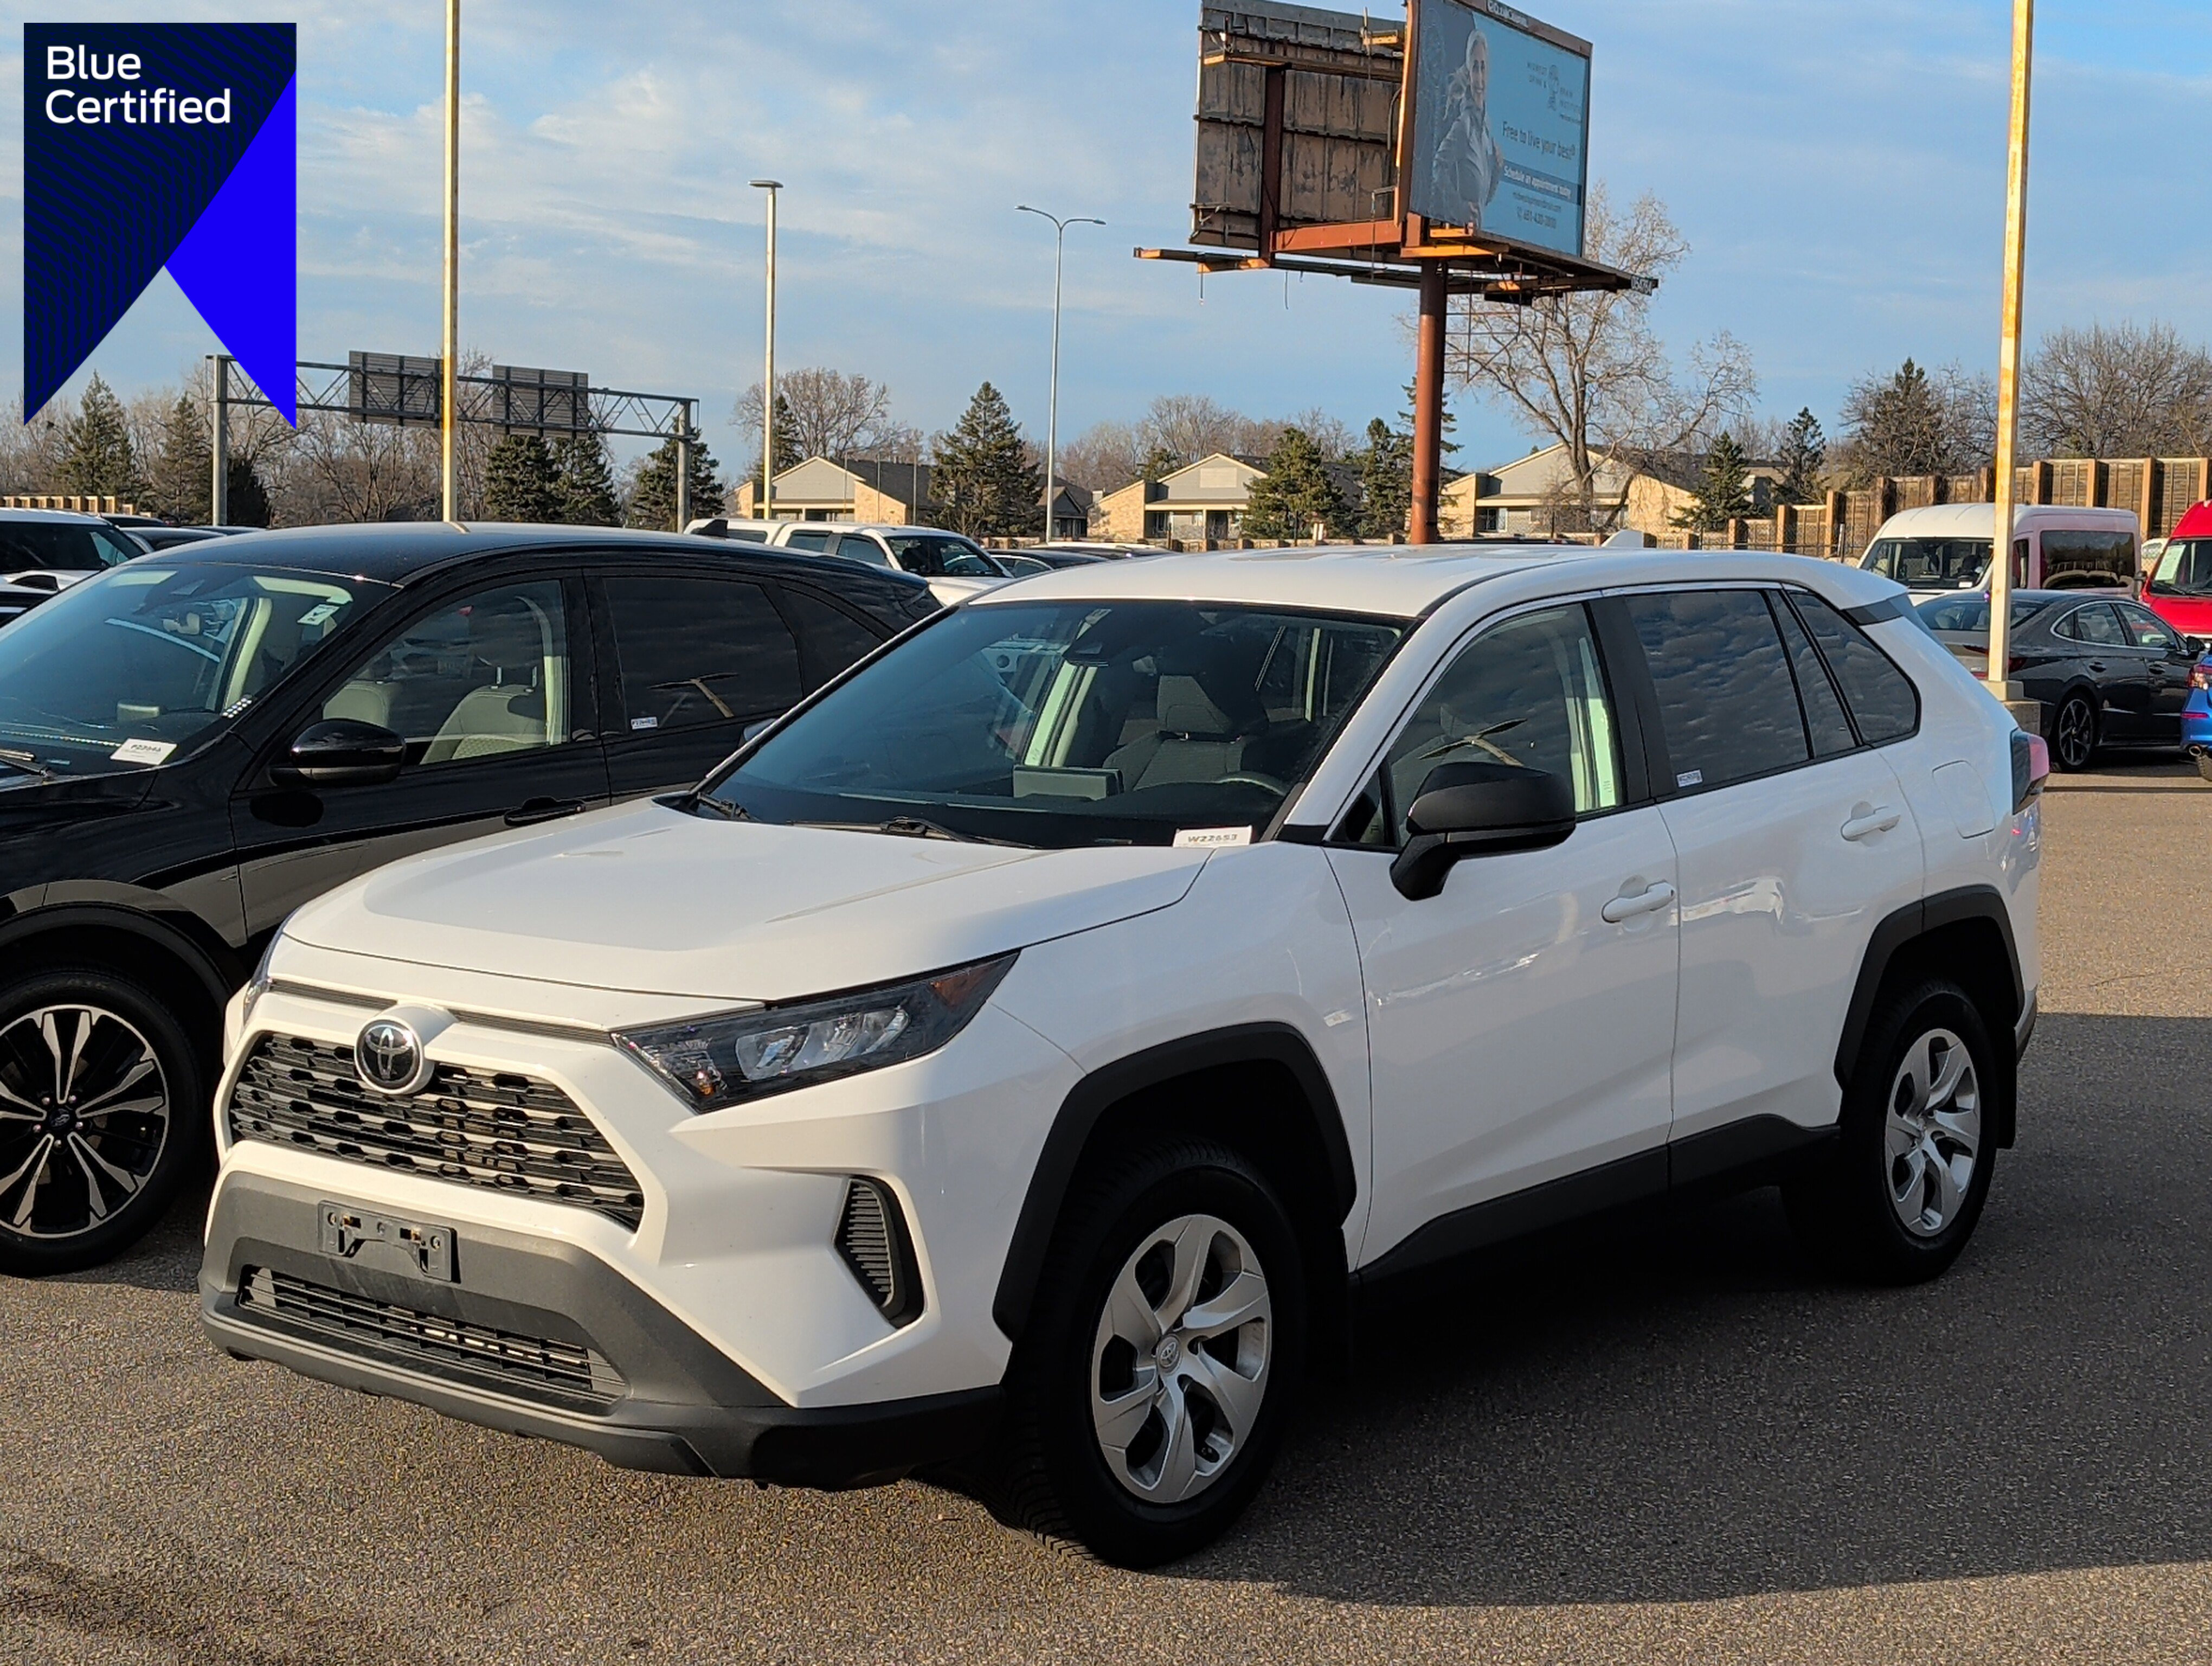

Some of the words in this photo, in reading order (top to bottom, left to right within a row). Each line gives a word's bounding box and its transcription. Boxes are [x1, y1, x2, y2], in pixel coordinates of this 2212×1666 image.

[1502, 121, 1517, 142] Free
[1519, 129, 1527, 144] to
[1528, 130, 1540, 149] live
[1541, 138, 1556, 155] your
